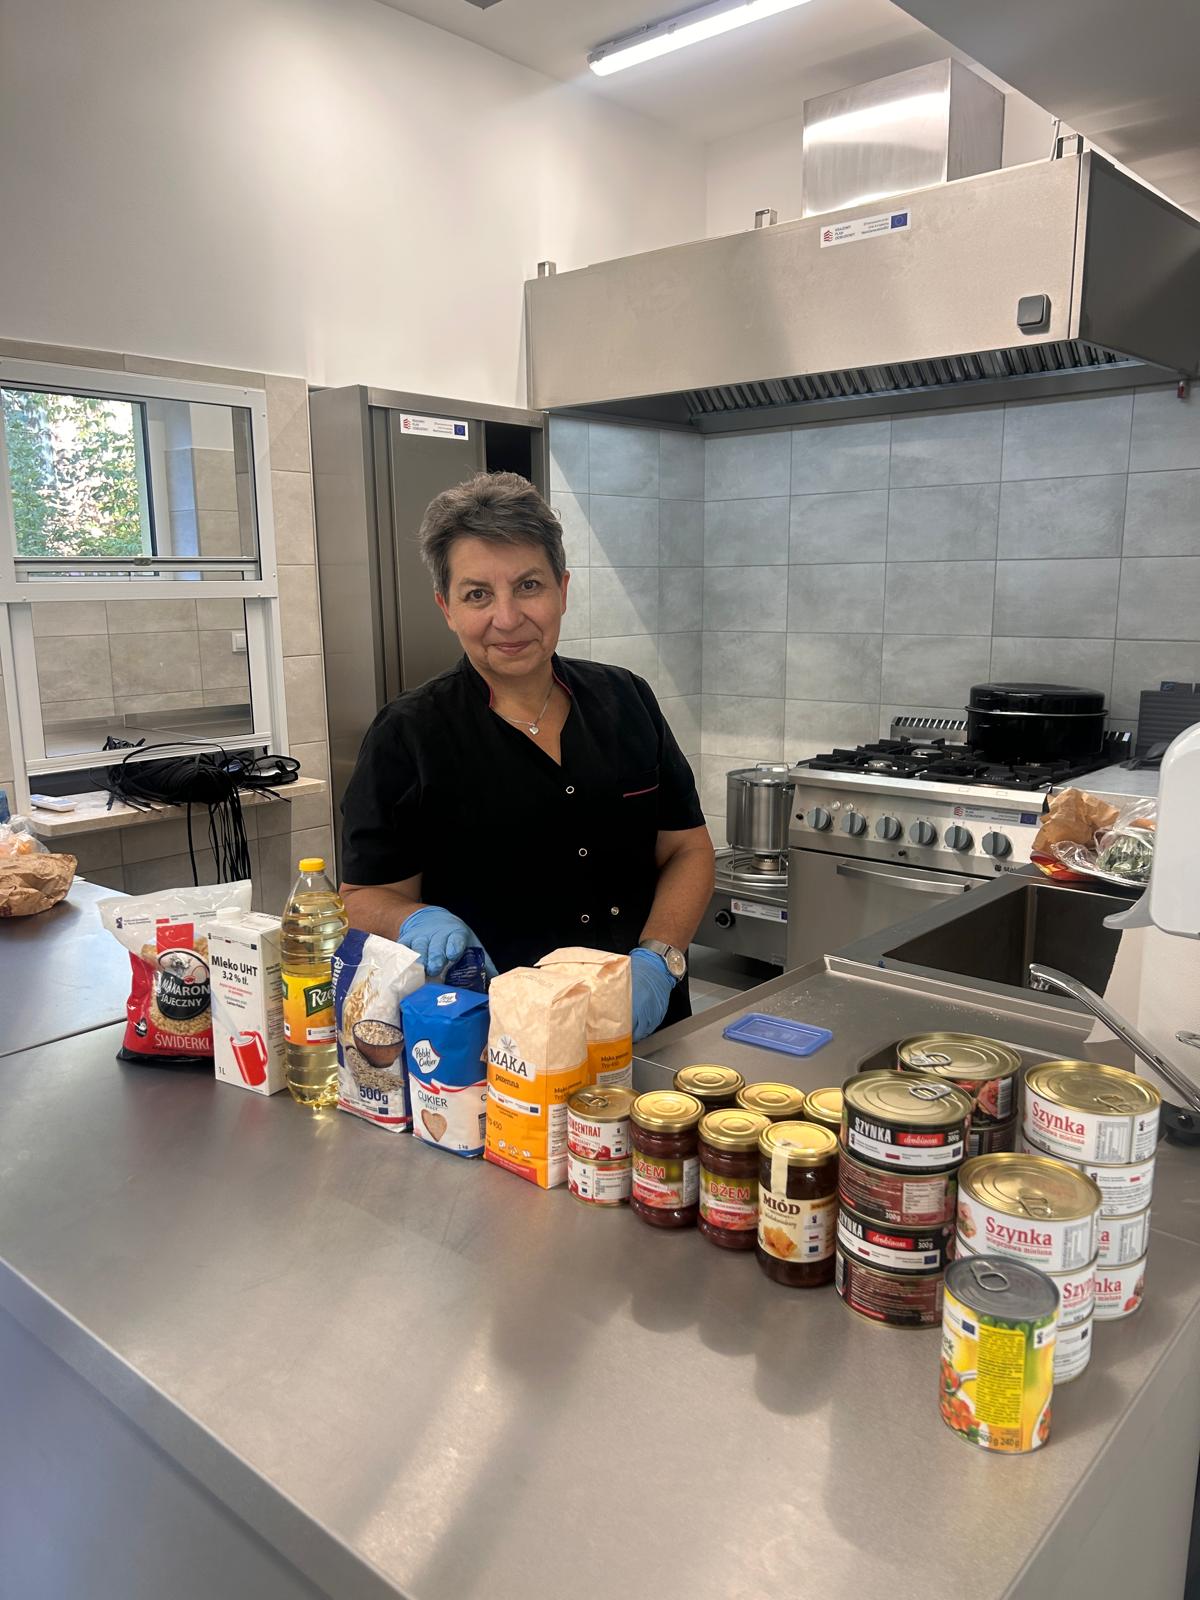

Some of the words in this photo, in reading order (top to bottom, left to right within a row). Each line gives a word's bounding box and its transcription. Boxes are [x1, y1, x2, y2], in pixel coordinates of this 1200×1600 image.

[211, 955, 239, 971] Mleko
[240, 962, 258, 977] UHT
[222, 970, 233, 981] 3,2
[234, 973, 241, 983] %
[161, 977, 211, 996] MAKARON
[160, 993, 203, 1008] JAJECZNY
[154, 1031, 210, 1050] ŚWIDERKI
[415, 1046, 431, 1060] Polski
[418, 1057, 437, 1068] Cukier
[490, 1048, 528, 1078] MĄKA
[495, 1073, 520, 1089] pszenna
[417, 1089, 448, 1108] CUKIER
[1032, 1101, 1085, 1136] Szynka
[855, 1116, 892, 1143] SZYNKA
[710, 1182, 750, 1200] DŻEM
[763, 1193, 800, 1215] MIÓD
[985, 1216, 1053, 1247] Szynka
[1023, 1247, 1053, 1256] mielona
